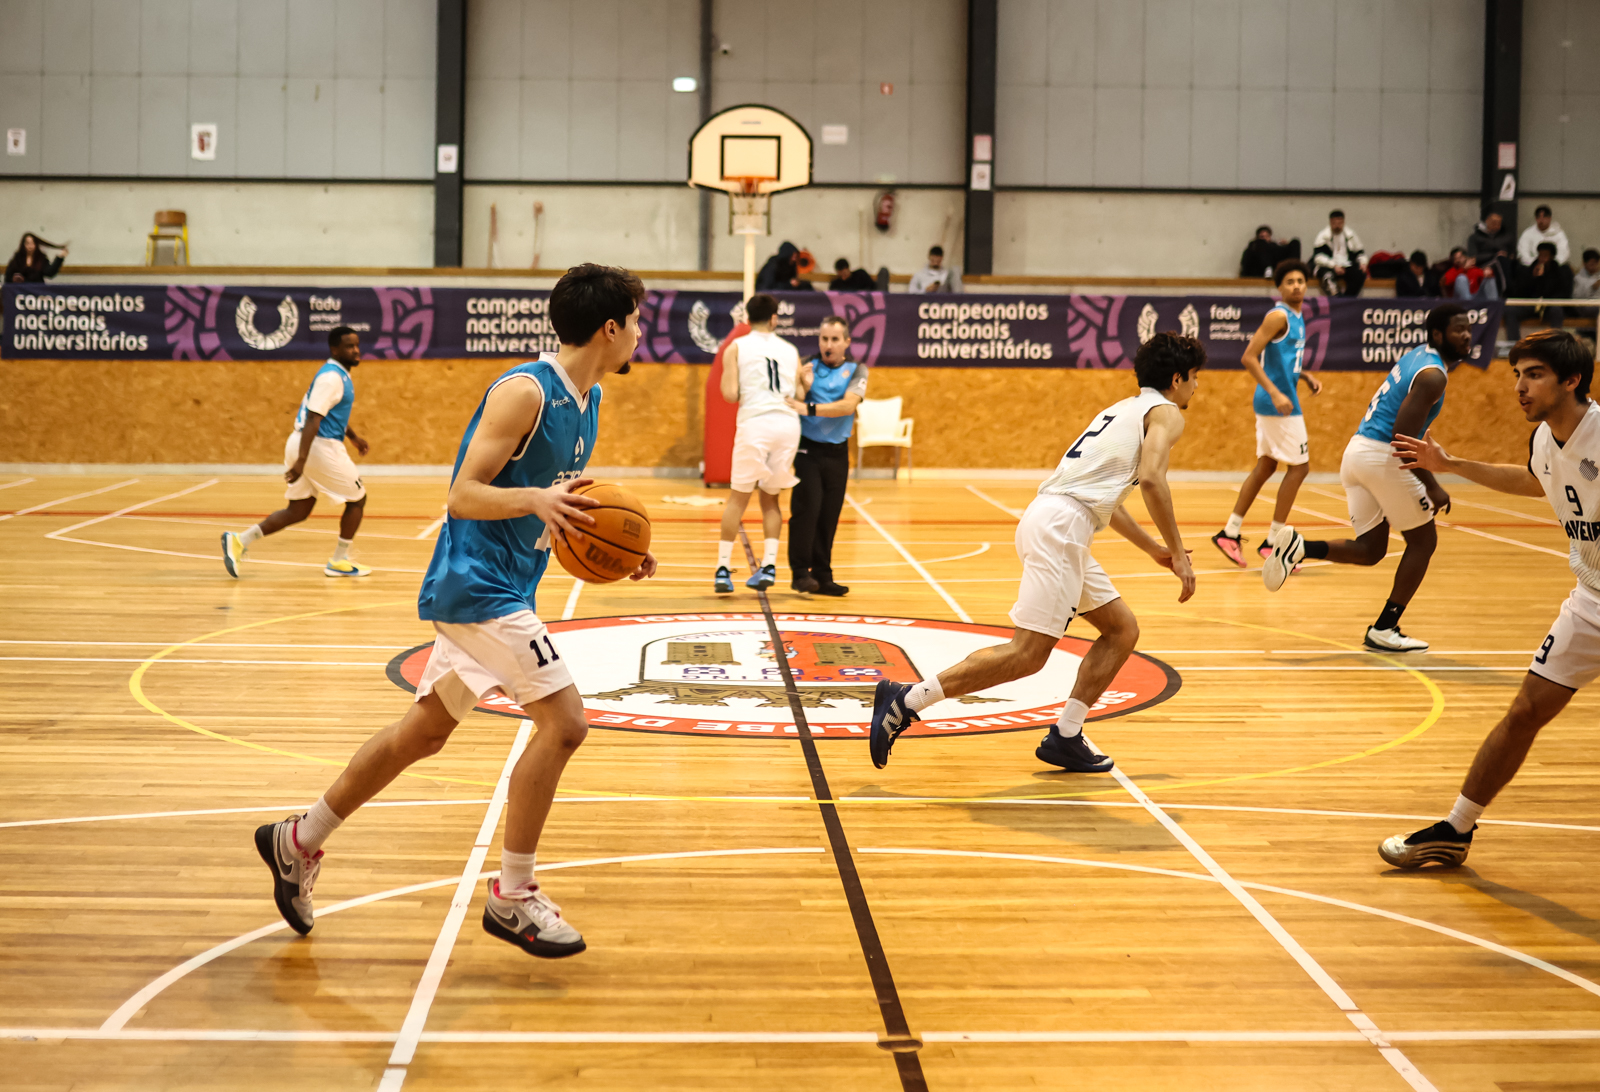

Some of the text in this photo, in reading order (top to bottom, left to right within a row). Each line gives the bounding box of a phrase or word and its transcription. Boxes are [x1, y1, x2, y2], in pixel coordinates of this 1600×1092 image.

[15, 293, 145, 314] campeonatos
[310, 295, 342, 311] fadu
[466, 298, 552, 318] campeon
[777, 300, 795, 315] du
[918, 300, 1048, 323] campeonatos
[1210, 304, 1241, 320] fadu
[15, 311, 106, 331] nacionais
[1362, 308, 1488, 328] campeos
[918, 320, 1011, 339] nacionais
[1362, 326, 1428, 344] nacion
[14, 330, 148, 351] universitários
[466, 335, 560, 352] universit
[917, 338, 1052, 359] universitários
[765, 357, 781, 393] 11
[1066, 415, 1117, 459] 2
[1565, 485, 1583, 516] 9
[1565, 520, 1600, 542] AVEIR
[529, 634, 560, 668] 11
[1535, 634, 1554, 664] 9
[590, 713, 676, 728] DE
[692, 721, 872, 734] LUBE
